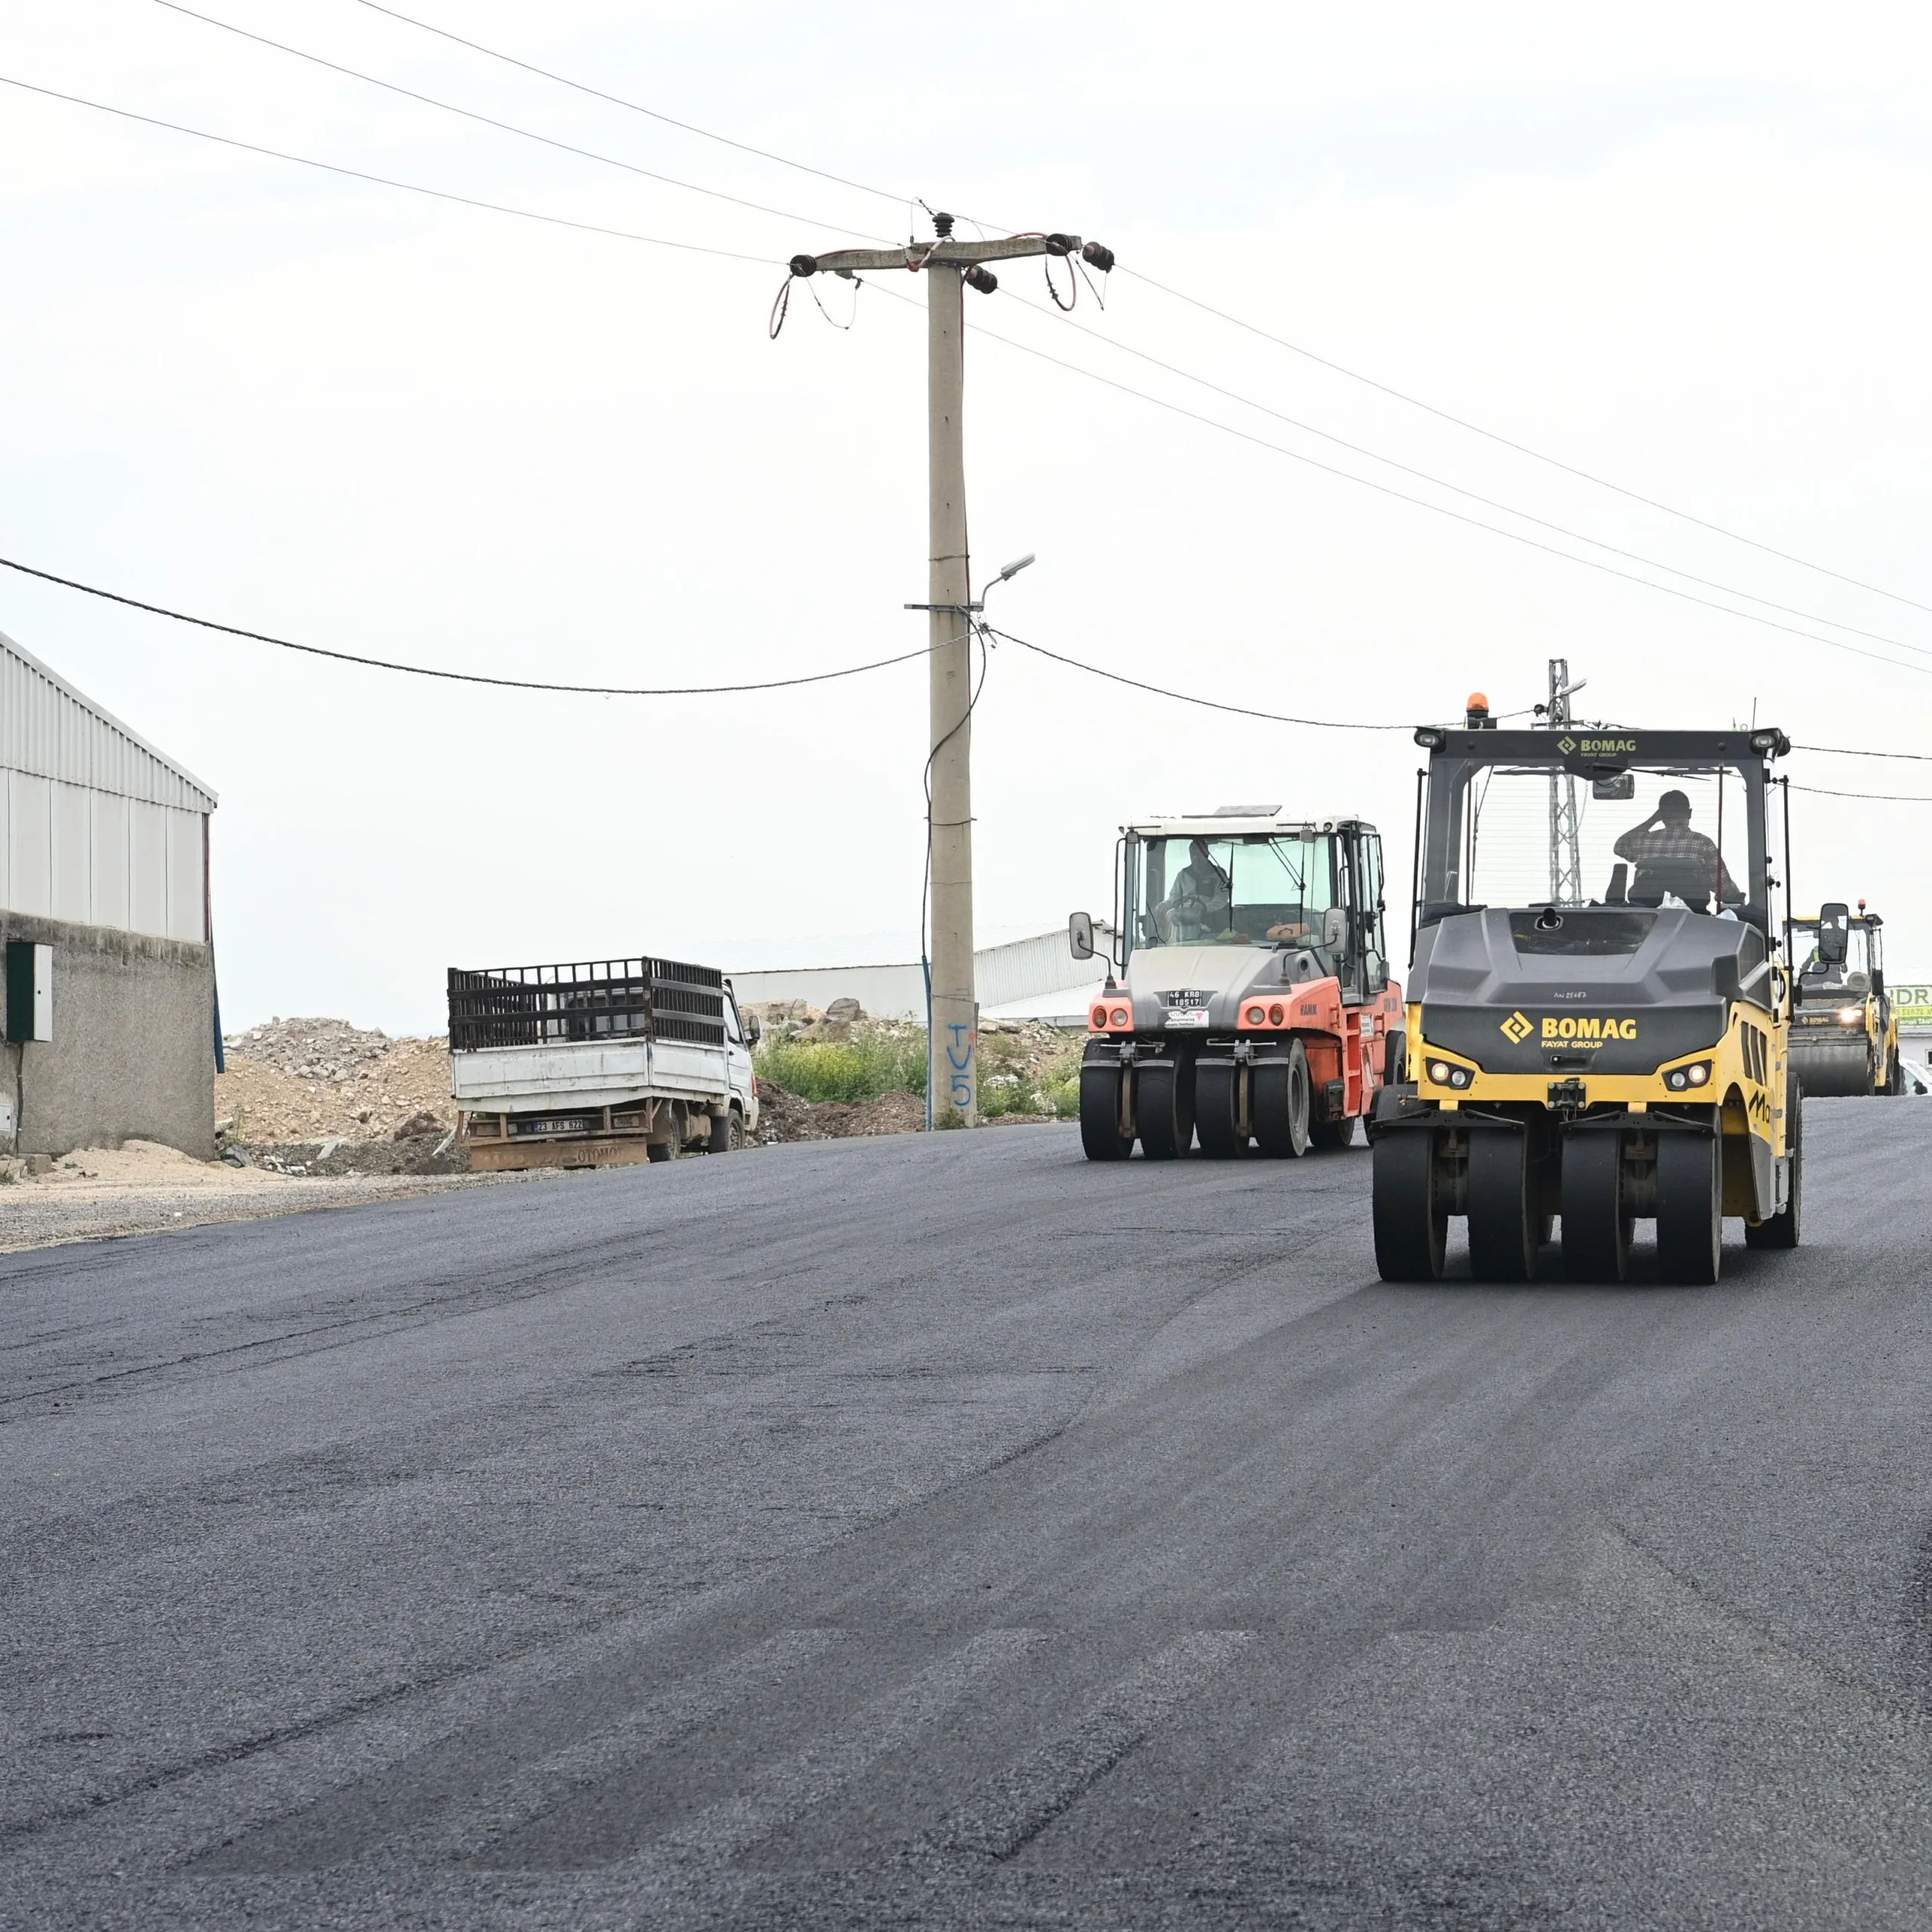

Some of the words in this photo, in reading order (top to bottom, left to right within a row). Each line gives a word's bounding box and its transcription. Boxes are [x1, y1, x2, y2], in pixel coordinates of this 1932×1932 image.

[1581, 740, 1636, 751] BOMAG
[1300, 1004, 1317, 1016] HAMM
[1542, 1018, 1637, 1039] BOMAG
[538, 1122, 547, 1131] 23
[552, 1121, 565, 1130] AFS
[569, 1120, 583, 1128] 622
